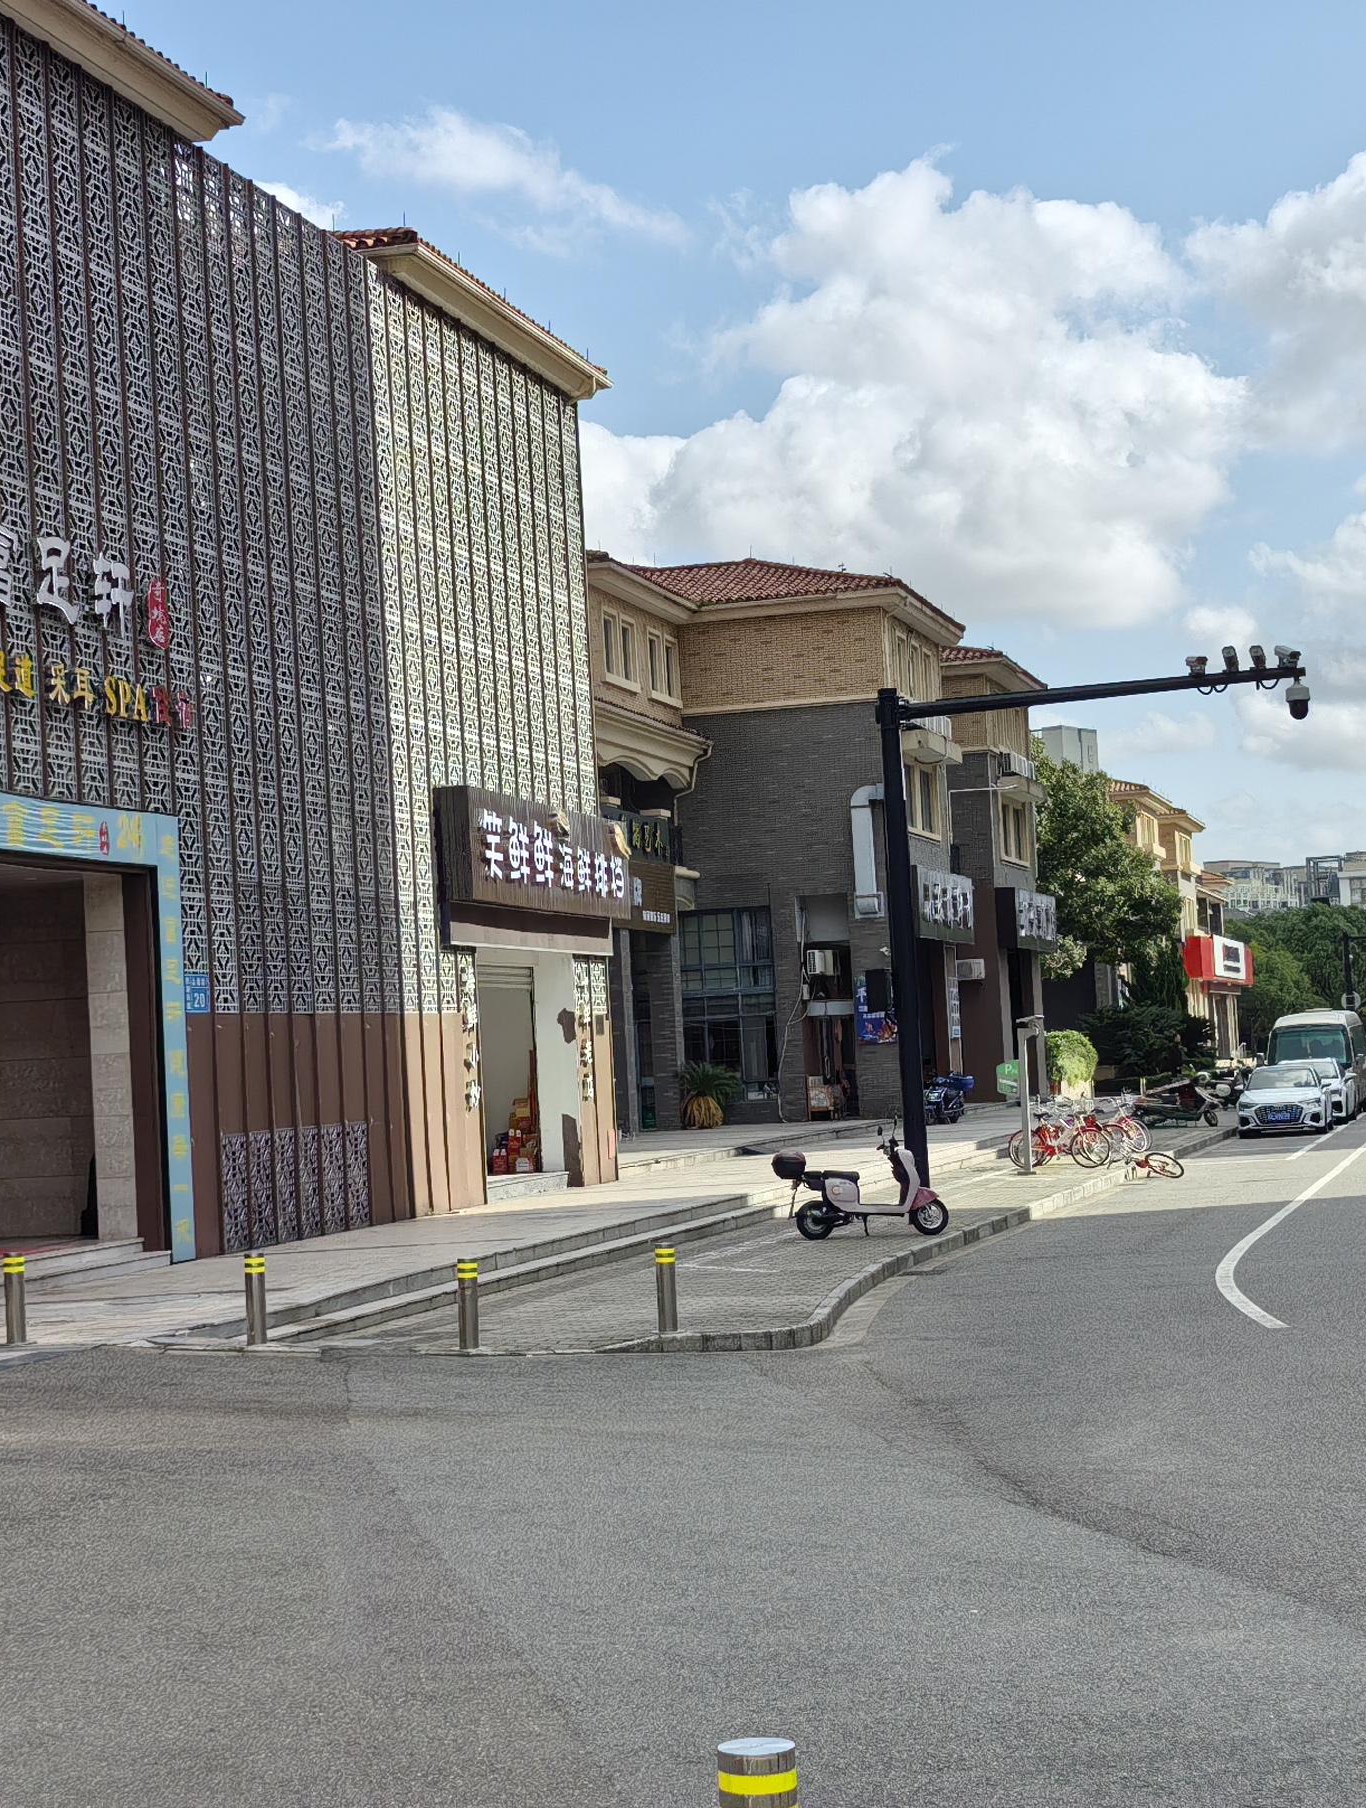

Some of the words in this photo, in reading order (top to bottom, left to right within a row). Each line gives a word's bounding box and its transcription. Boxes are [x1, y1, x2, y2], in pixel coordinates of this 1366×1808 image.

[49, 663, 95, 709] 采耳
[105, 677, 148, 723] SPA
[558, 842, 625, 898] 海鲜排档
[193, 992, 206, 1008] 20
